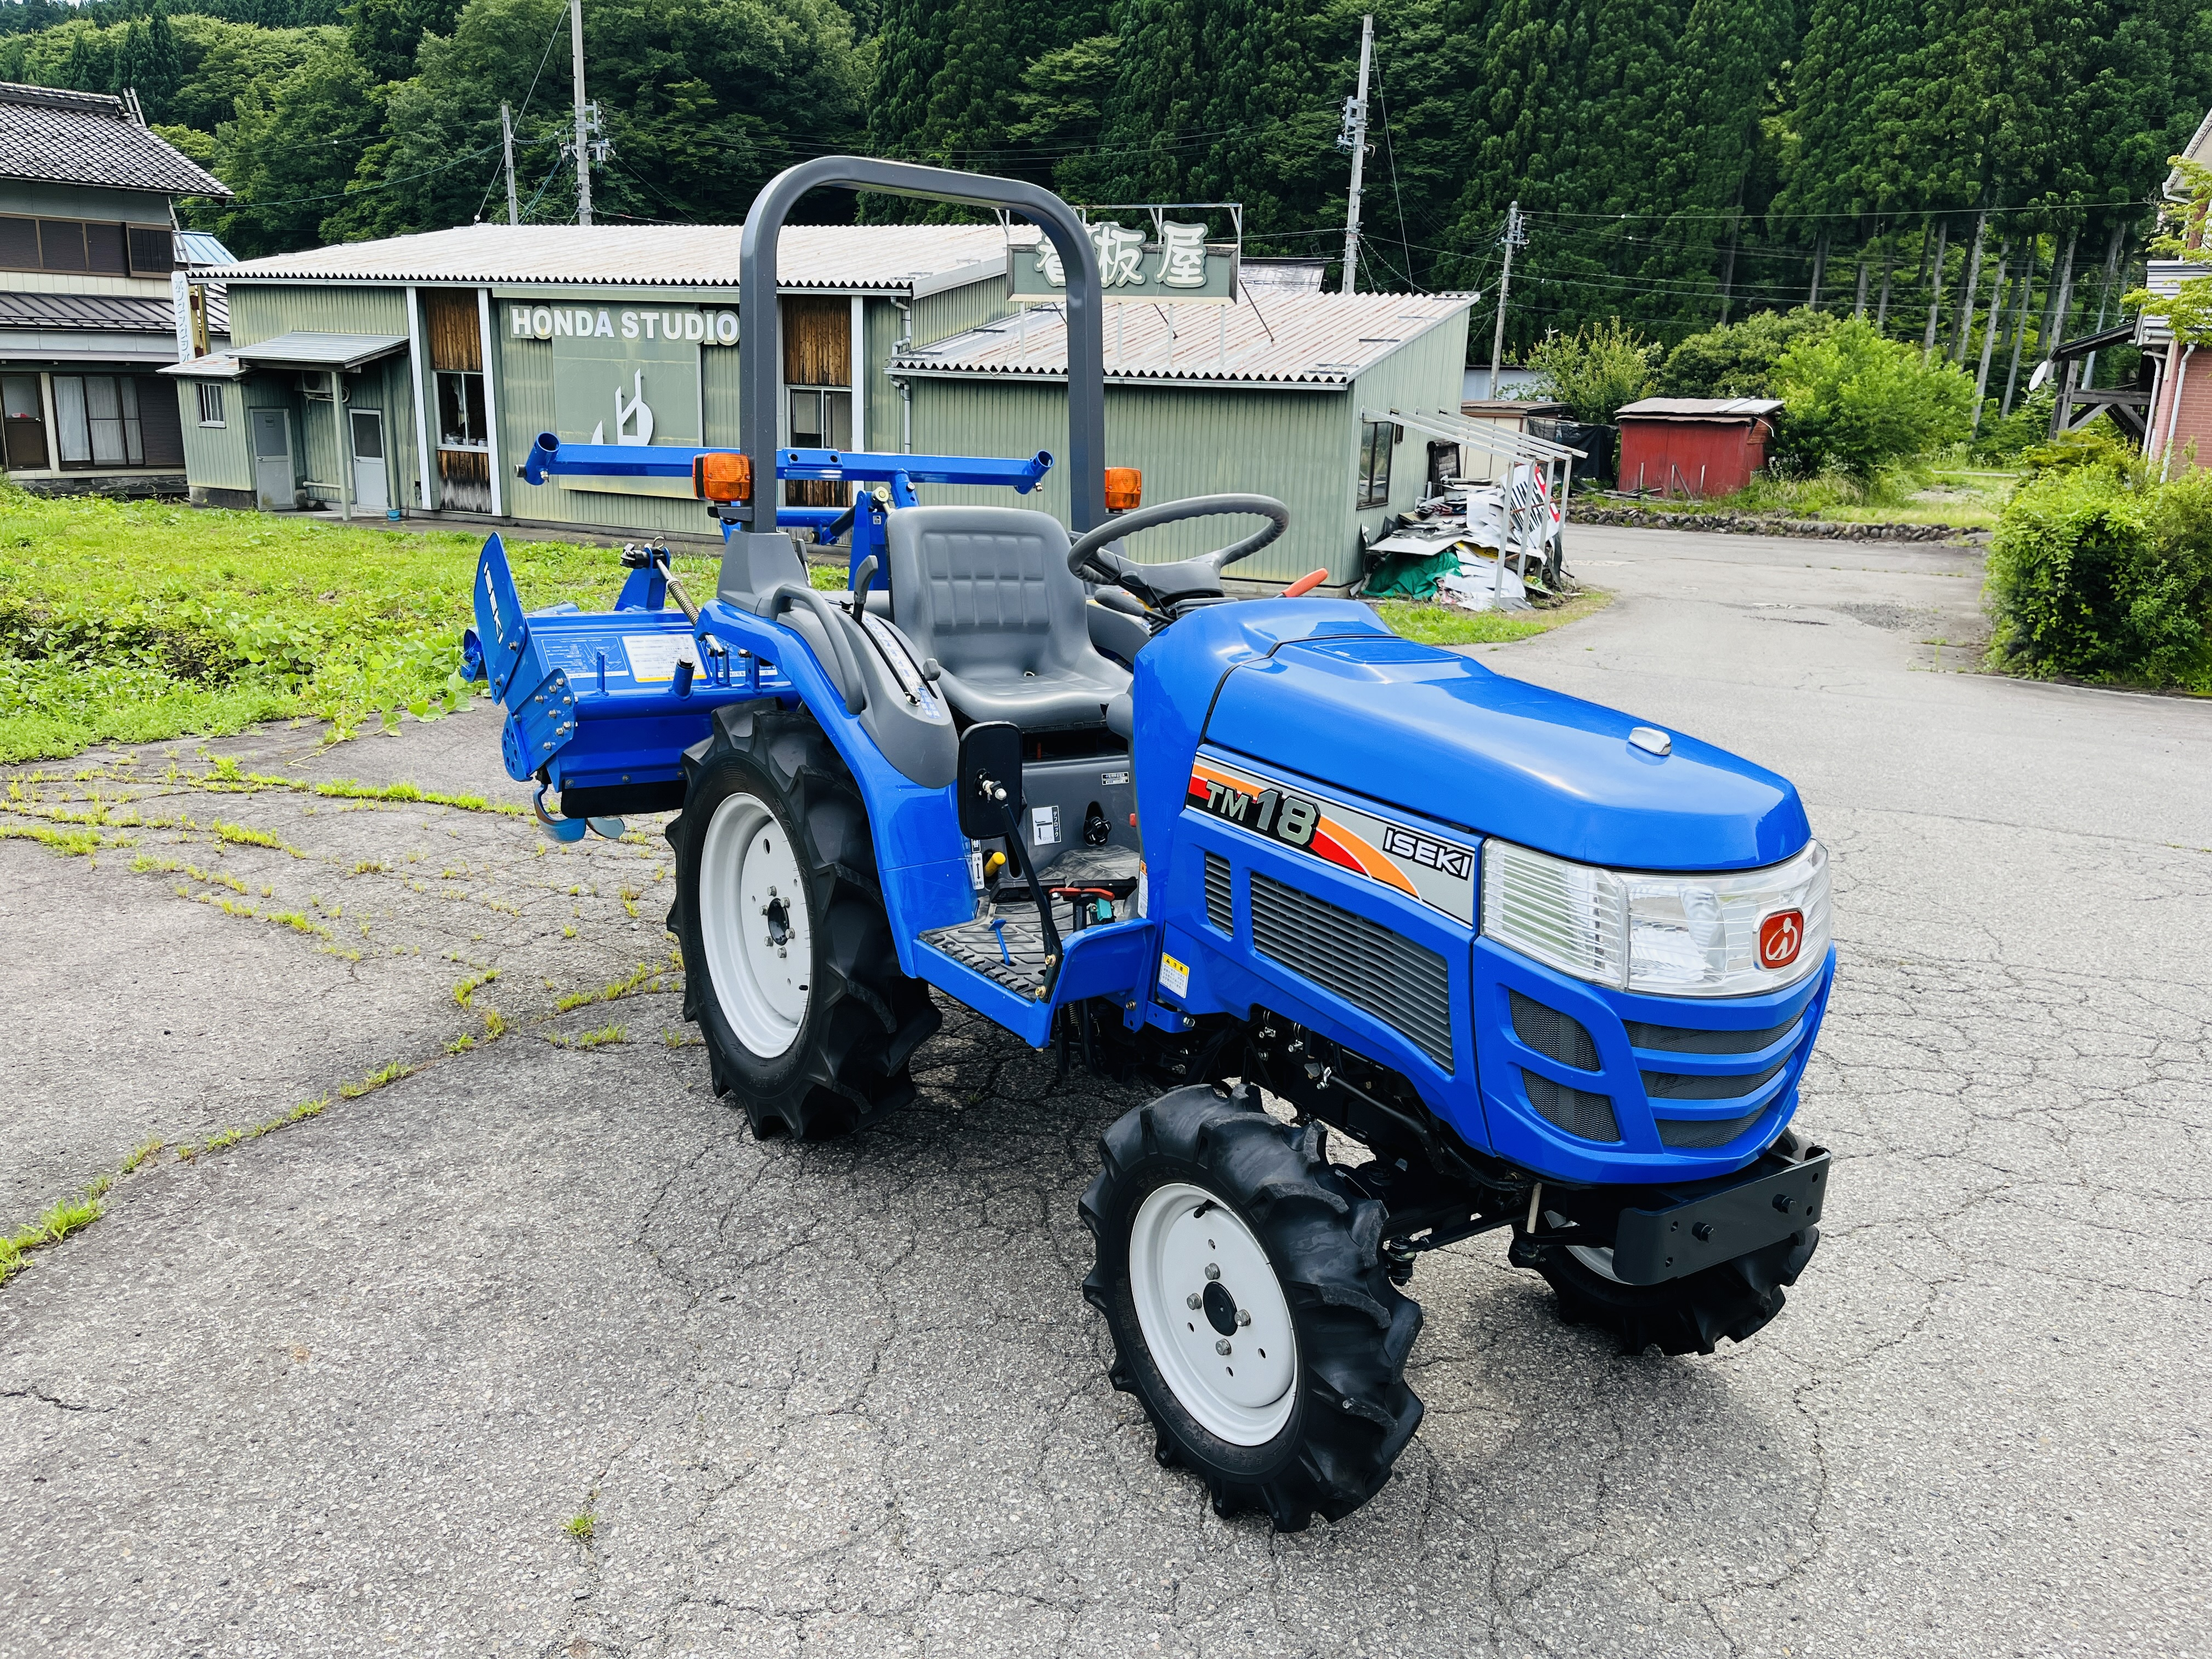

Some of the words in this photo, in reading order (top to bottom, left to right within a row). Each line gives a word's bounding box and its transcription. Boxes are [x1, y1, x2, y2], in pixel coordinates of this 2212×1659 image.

[512, 308, 614, 338] HONDA
[621, 311, 738, 342] STUDIO
[484, 561, 504, 644] ISEKI
[1384, 828, 1471, 878] ISEKI
